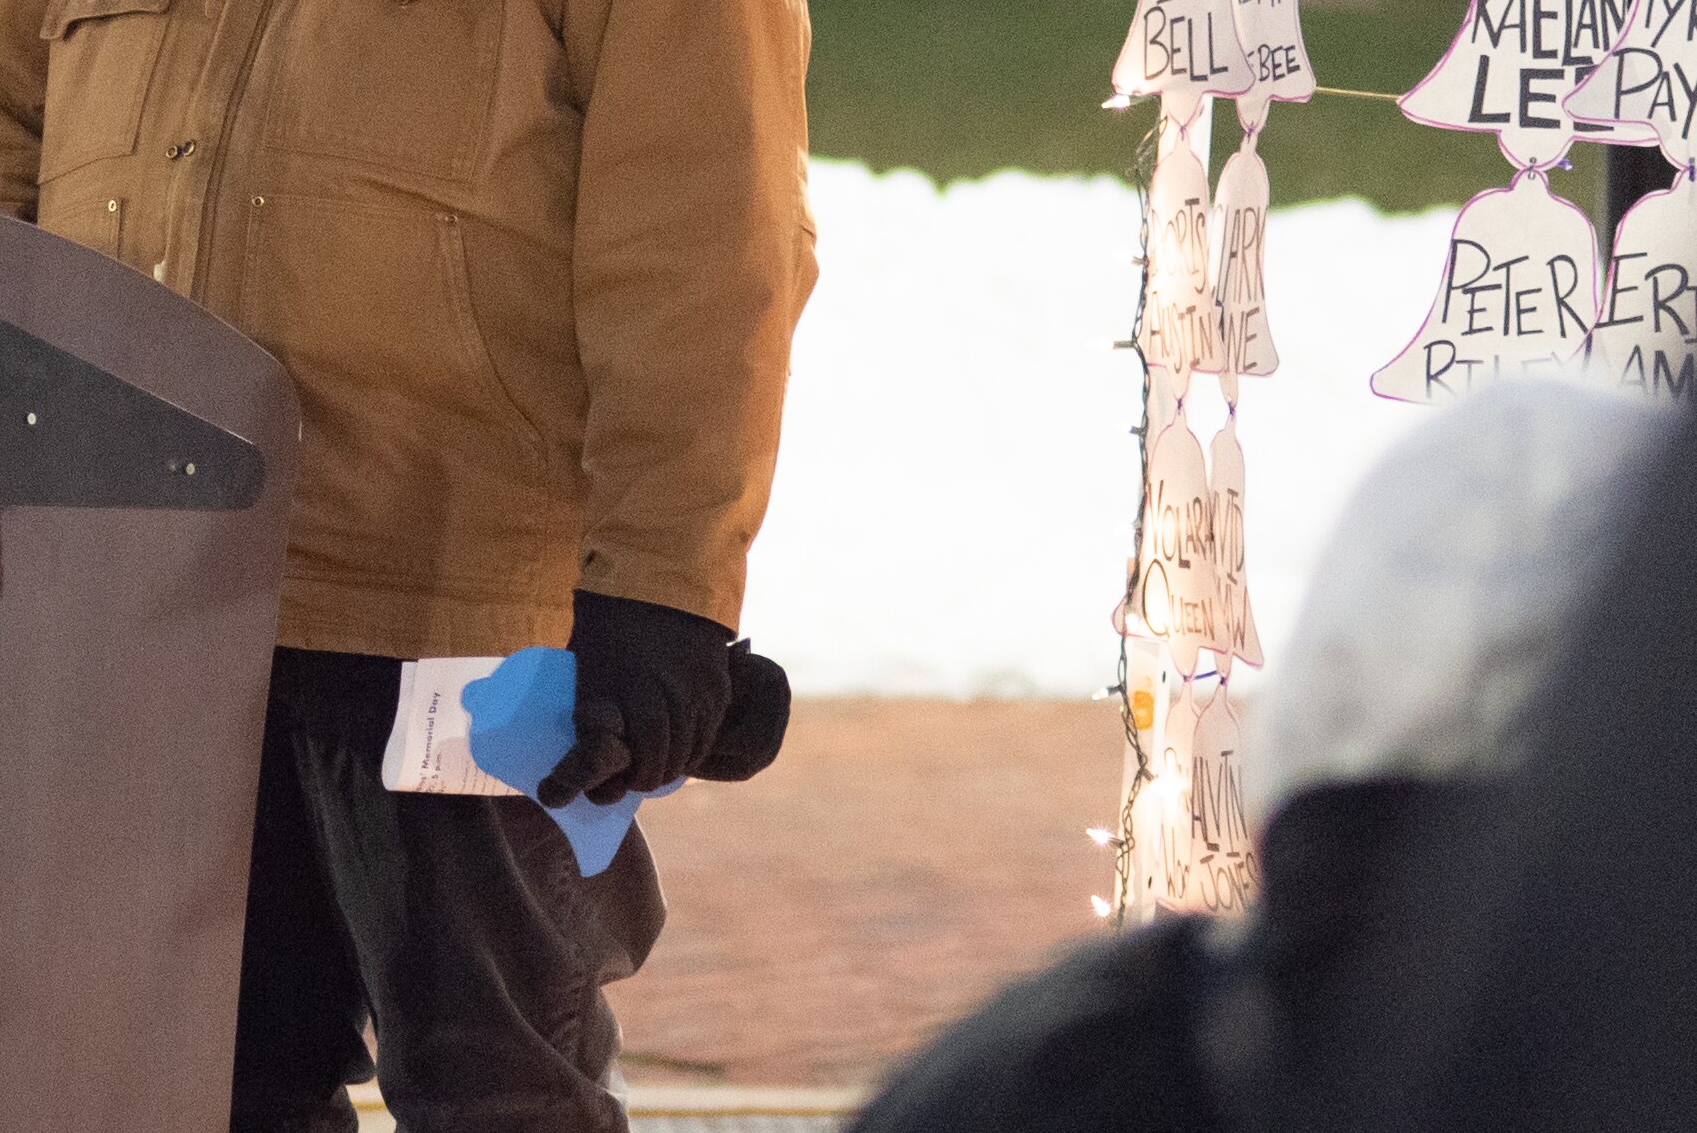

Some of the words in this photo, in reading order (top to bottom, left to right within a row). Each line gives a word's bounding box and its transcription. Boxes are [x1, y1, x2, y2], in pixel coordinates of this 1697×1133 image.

[1143, 5, 1229, 82] BELL
[1247, 43, 1302, 83] BEE
[1442, 238, 1590, 339] PETER
[1141, 558, 1216, 642] QUEEN
[421, 717, 435, 769] Memorial
[429, 691, 441, 714] Day
